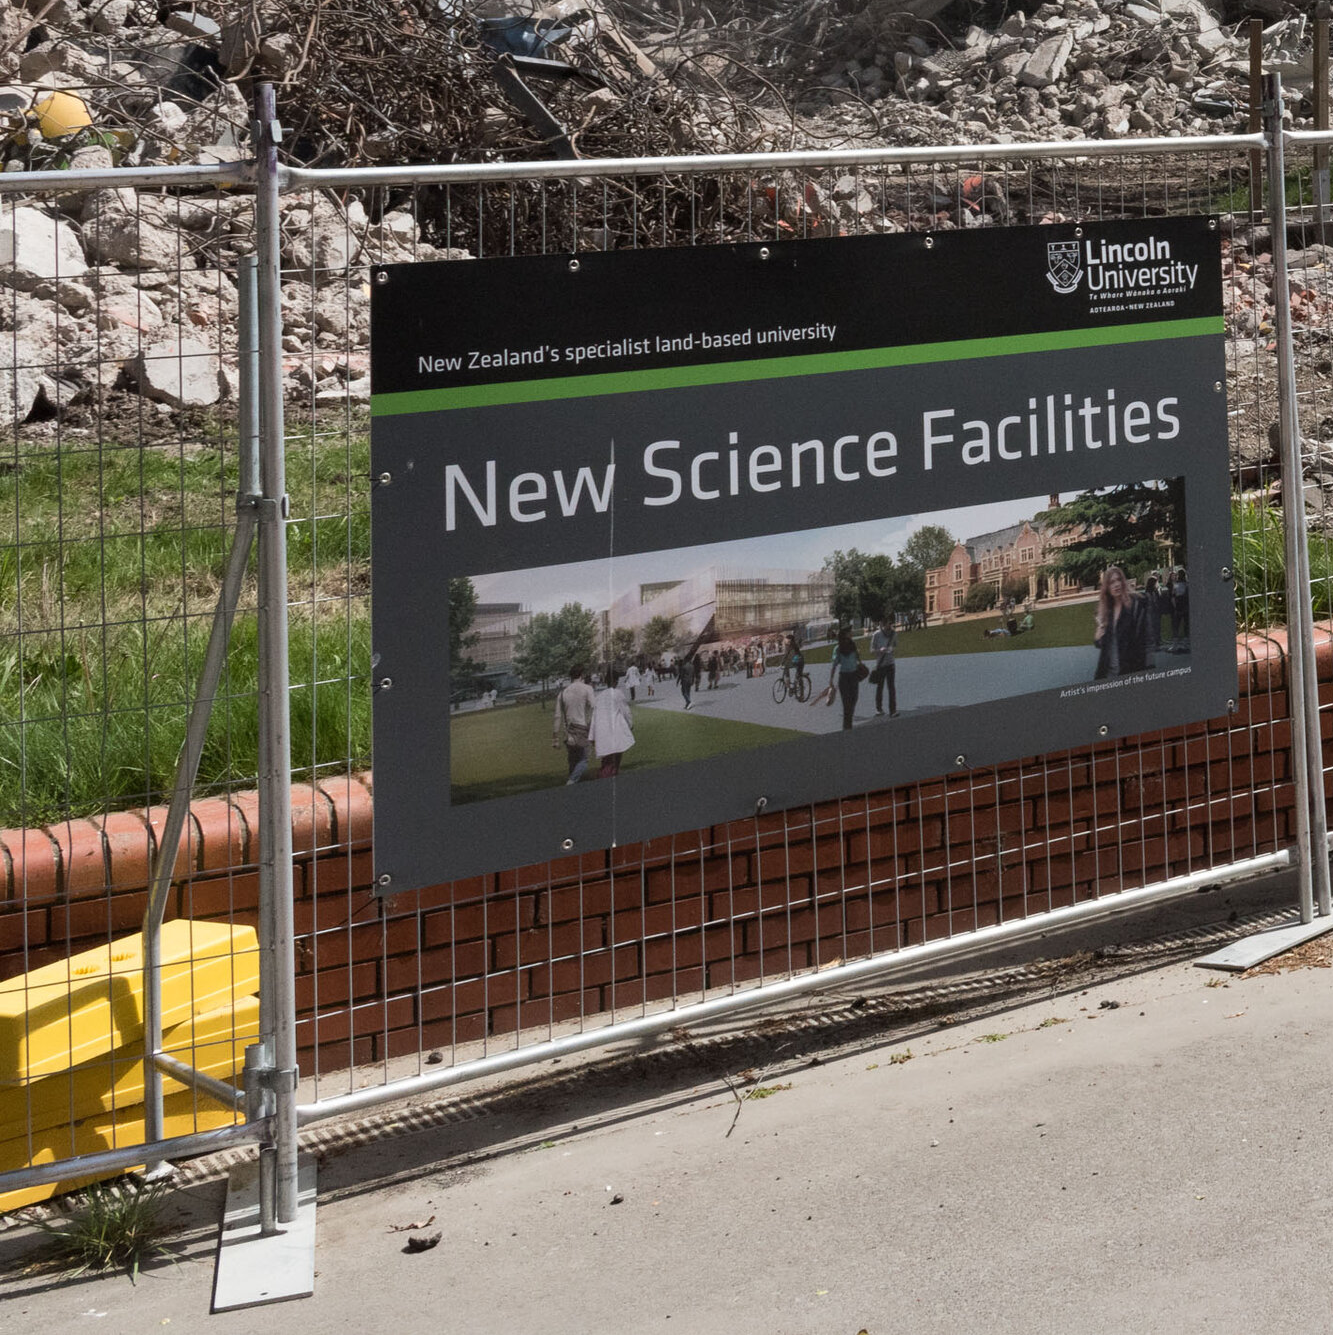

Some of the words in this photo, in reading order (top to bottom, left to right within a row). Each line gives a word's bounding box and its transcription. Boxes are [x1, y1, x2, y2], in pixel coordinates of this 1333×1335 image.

[1086, 236, 1171, 264] Lincoln
[1087, 260, 1198, 291] University
[1145, 300, 1175, 309] ZEALAND
[418, 355, 462, 373] New
[468, 345, 560, 369] Zealand's
[565, 337, 651, 364] specialist
[655, 328, 752, 353] land-based
[757, 322, 837, 345] university
[444, 459, 616, 532] New
[642, 429, 898, 508] Science
[922, 389, 1182, 471] Facilities
[1060, 687, 1086, 698] Artist's
[1087, 679, 1123, 693] impression
[1124, 676, 1132, 686] of
[1133, 674, 1144, 683] the
[1145, 671, 1166, 681] future
[1166, 666, 1192, 678] campus
